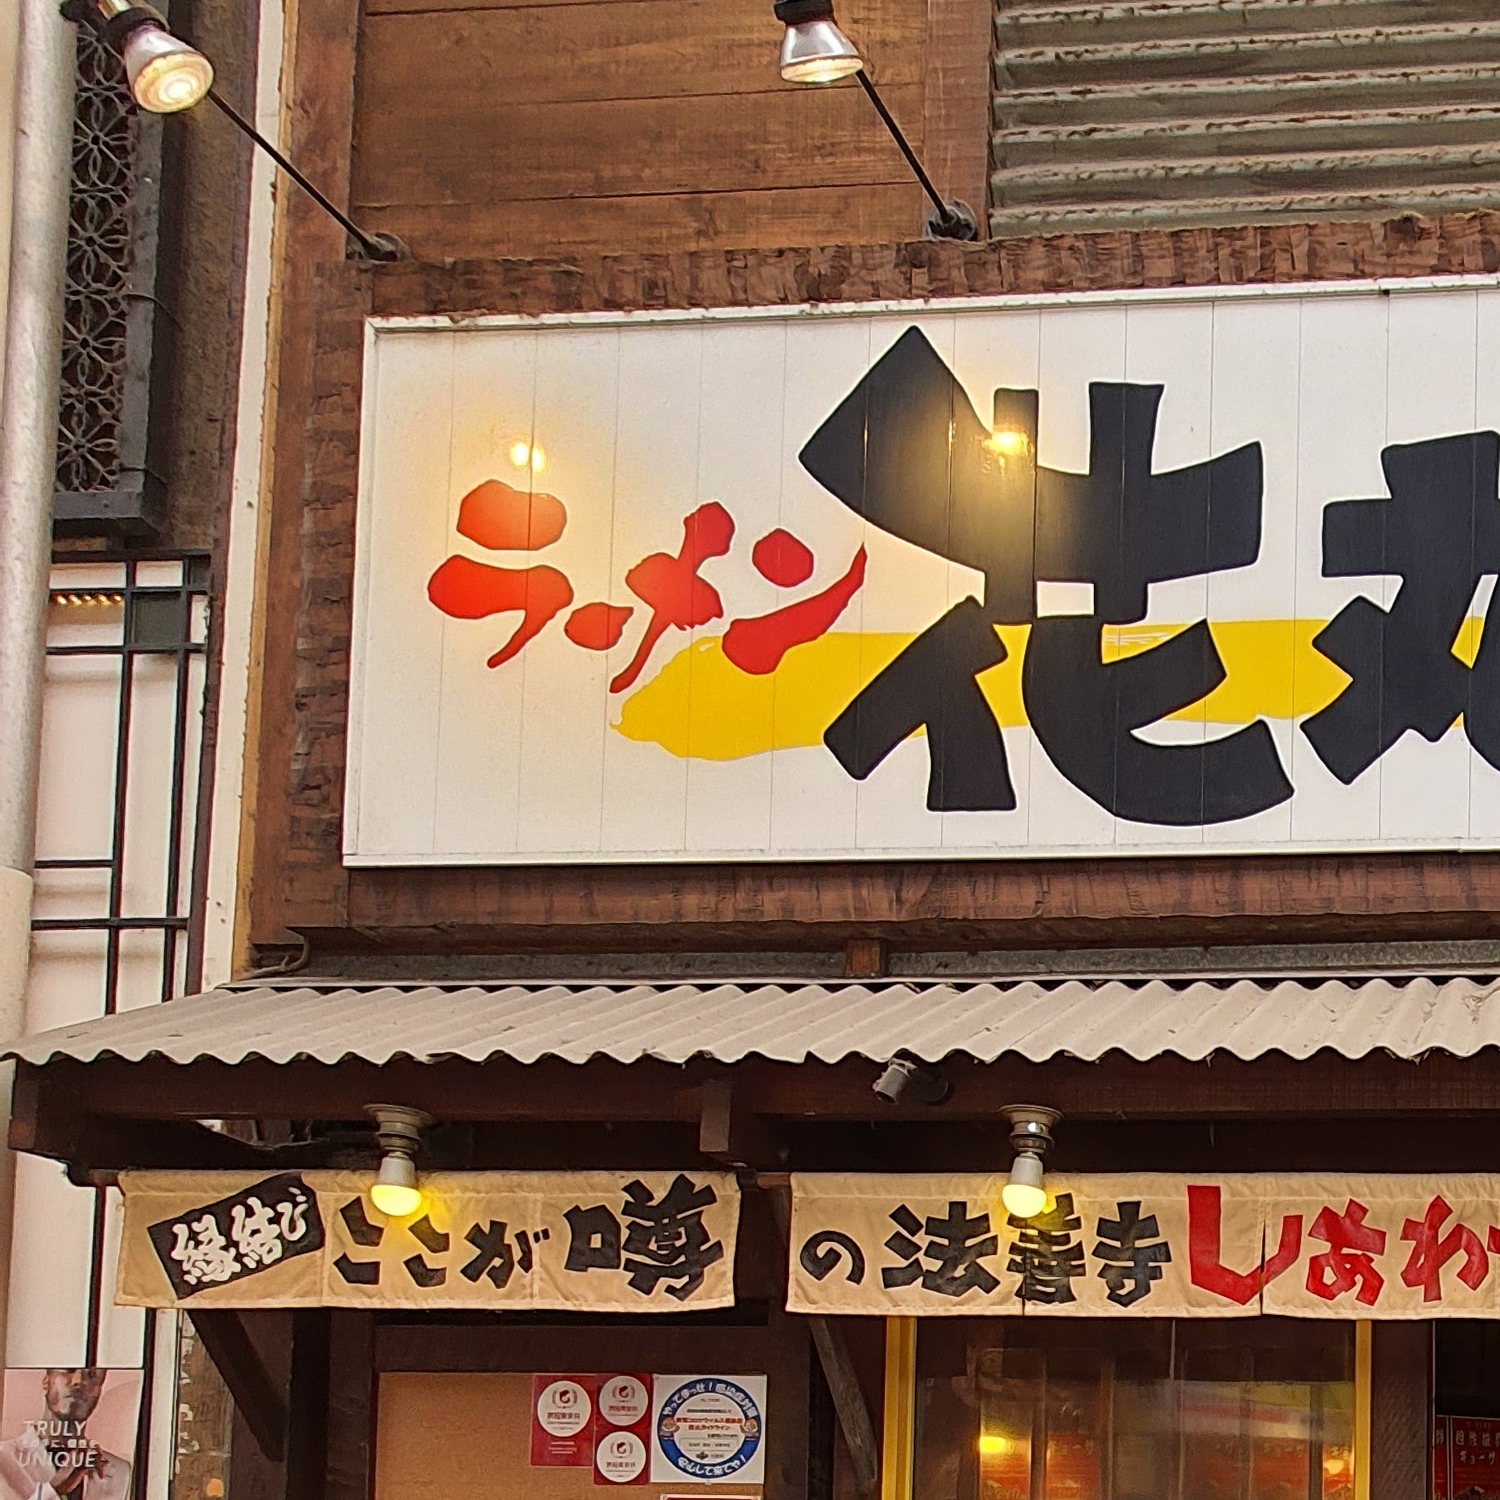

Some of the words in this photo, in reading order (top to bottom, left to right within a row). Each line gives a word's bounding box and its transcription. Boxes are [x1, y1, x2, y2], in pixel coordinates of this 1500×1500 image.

[428, 477, 865, 692] ラーメン
[171, 1187, 308, 1285] 縁結び
[23, 1421, 86, 1436] TRULY
[19, 1452, 97, 1468] UNIQUE
